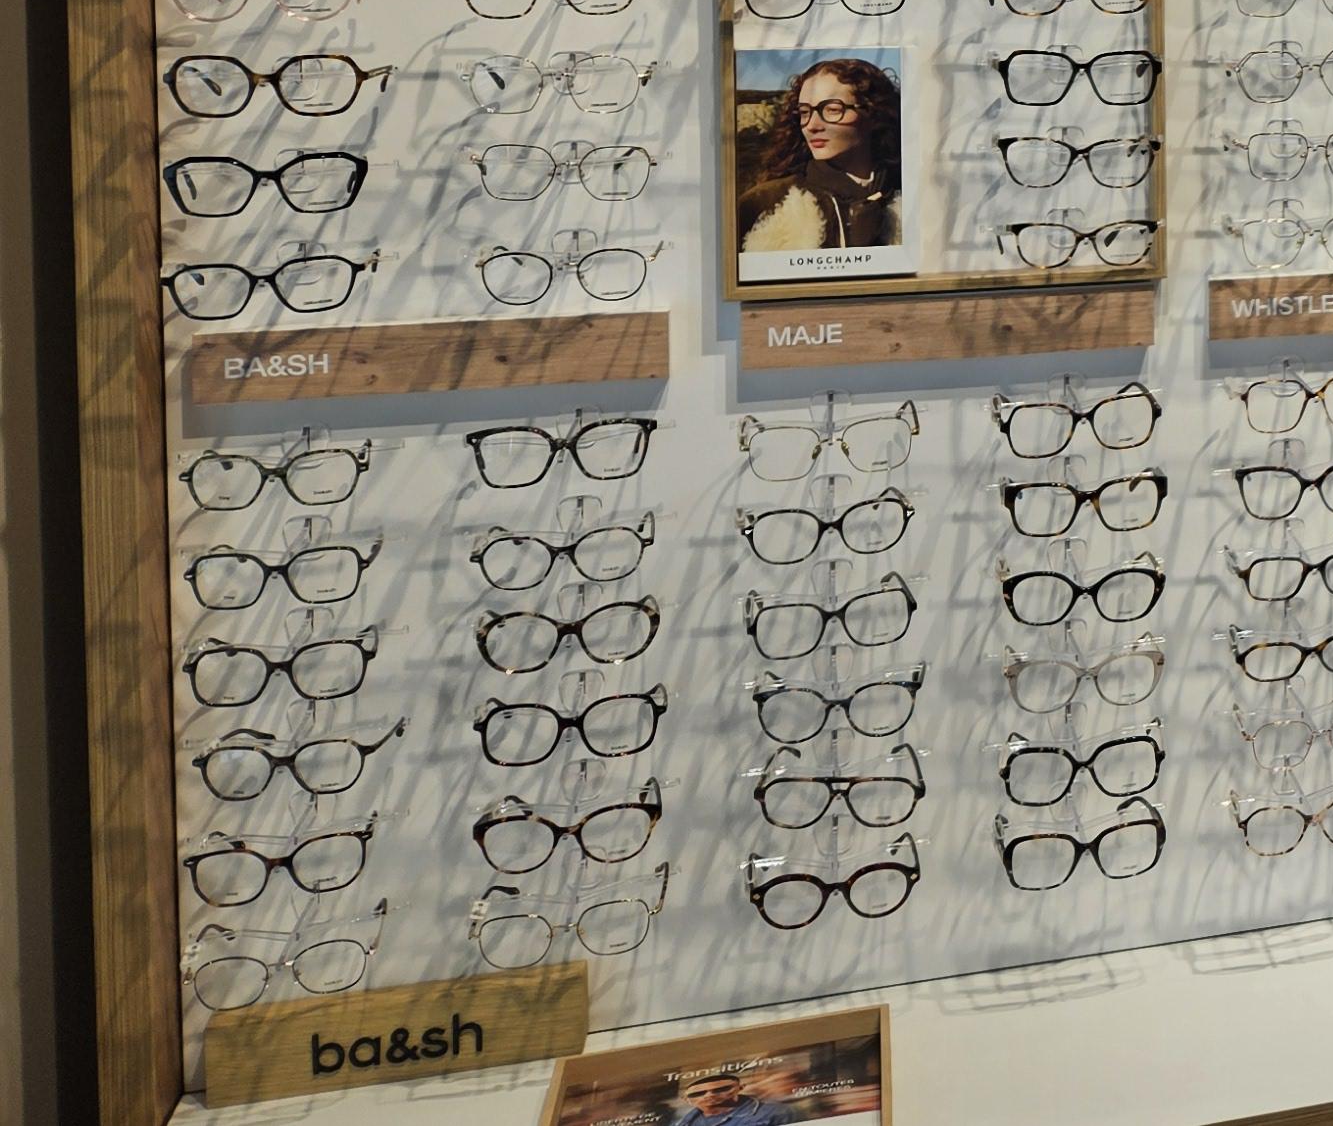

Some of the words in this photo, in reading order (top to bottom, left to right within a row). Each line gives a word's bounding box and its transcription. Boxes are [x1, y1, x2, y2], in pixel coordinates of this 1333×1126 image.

[789, 254, 873, 267] LONGCHAMP
[768, 323, 843, 347] MAJE
[224, 354, 329, 379] BA&SH
[311, 1014, 483, 1075] ba&sh
[665, 1055, 785, 1082] Transitions
